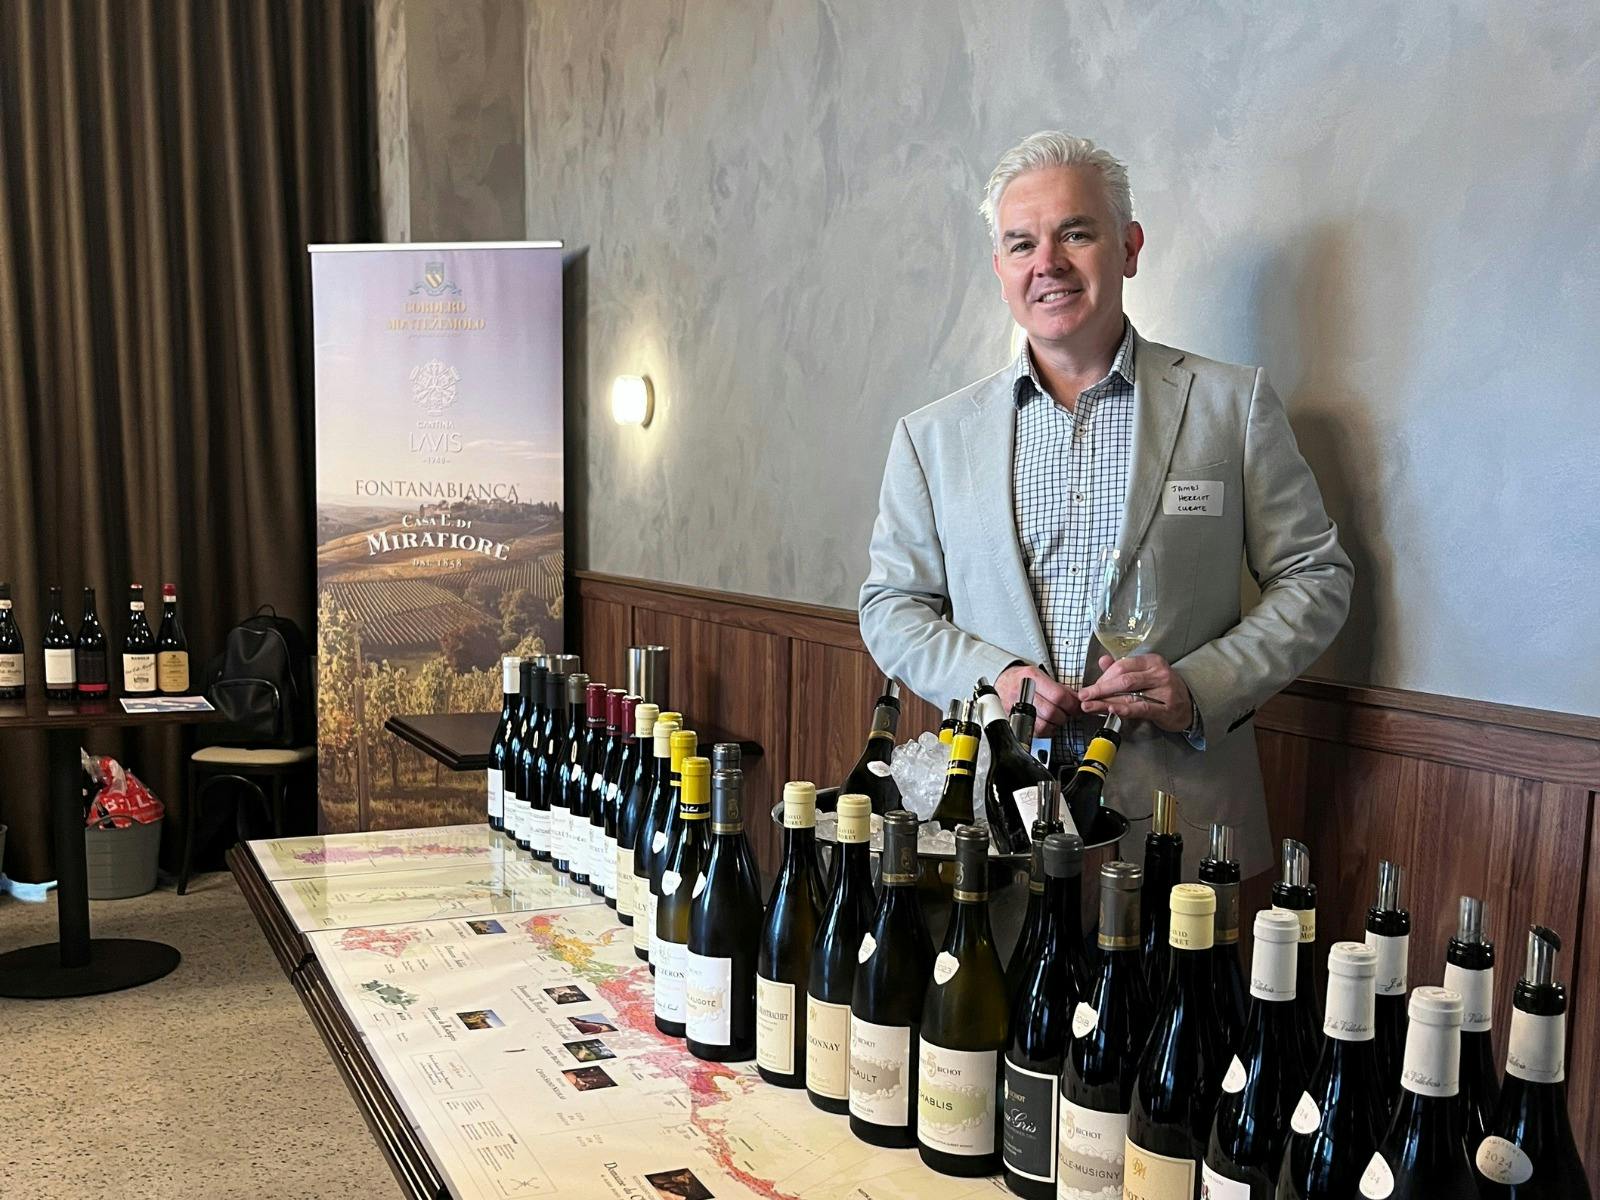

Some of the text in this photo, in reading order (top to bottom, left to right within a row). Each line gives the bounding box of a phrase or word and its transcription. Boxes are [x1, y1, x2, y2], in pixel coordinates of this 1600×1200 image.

[408, 432, 463, 454] LAVIS
[355, 479, 518, 502] FONTANABIANCA
[366, 528, 511, 561] MIRAFIORE
[936, 1066, 962, 1078] BICHOT
[1011, 1108, 1037, 1134] Gris
[1484, 1150, 1513, 1170] 2024
